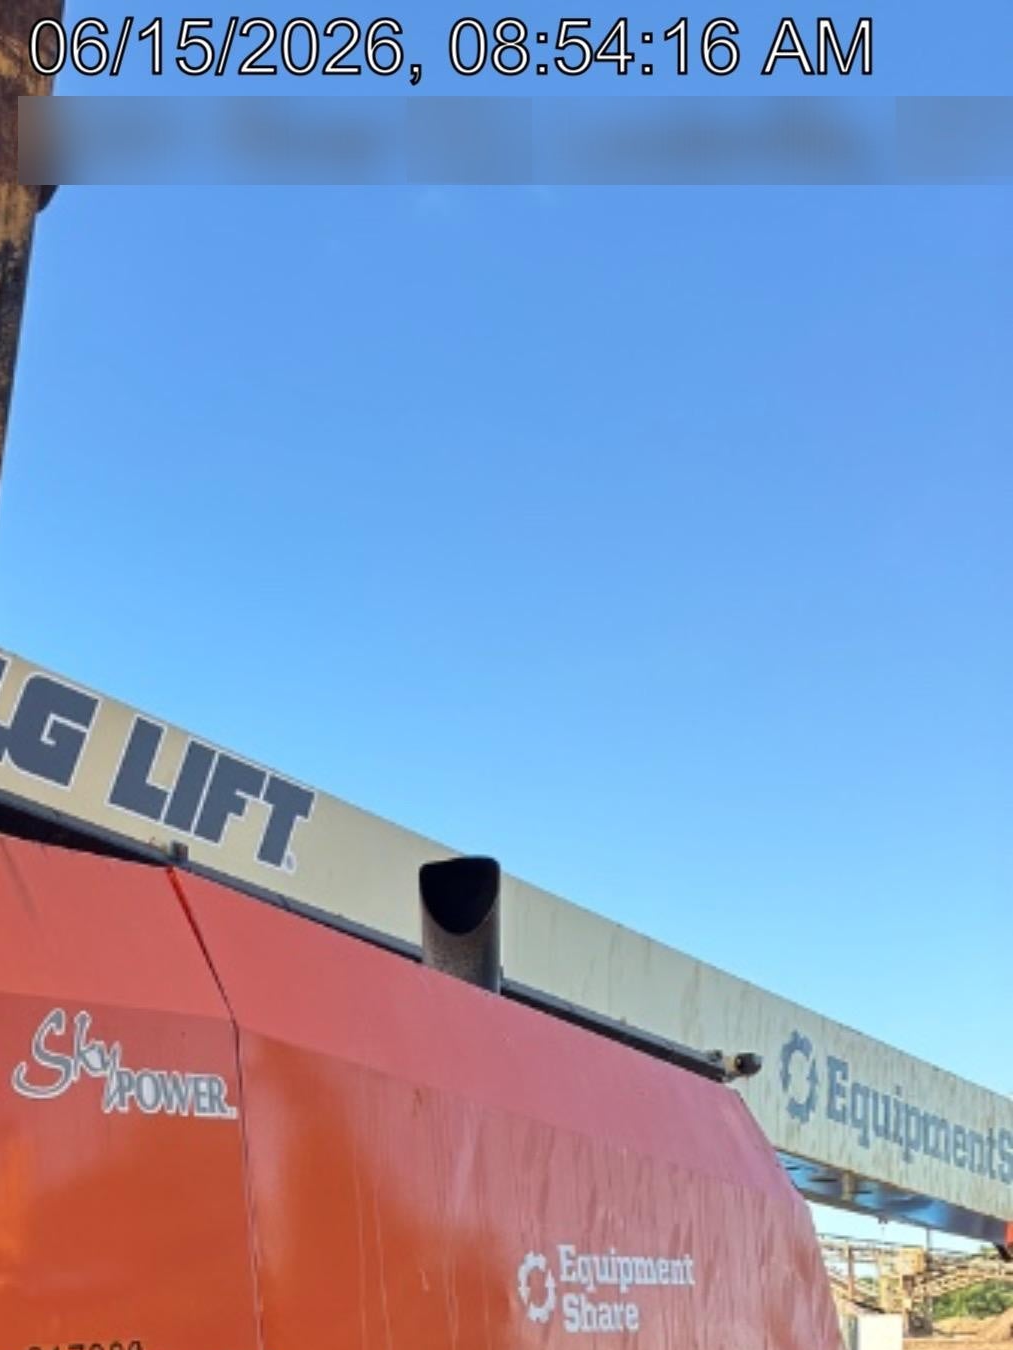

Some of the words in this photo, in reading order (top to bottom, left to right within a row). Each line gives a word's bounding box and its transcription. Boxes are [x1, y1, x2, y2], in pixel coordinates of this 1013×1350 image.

[107, 713, 317, 870] LIFT
[11, 1007, 122, 1113] Sky
[112, 1068, 238, 1119] POWER
[557, 1243, 696, 1294] Equipment
[562, 1292, 640, 1334] Share
